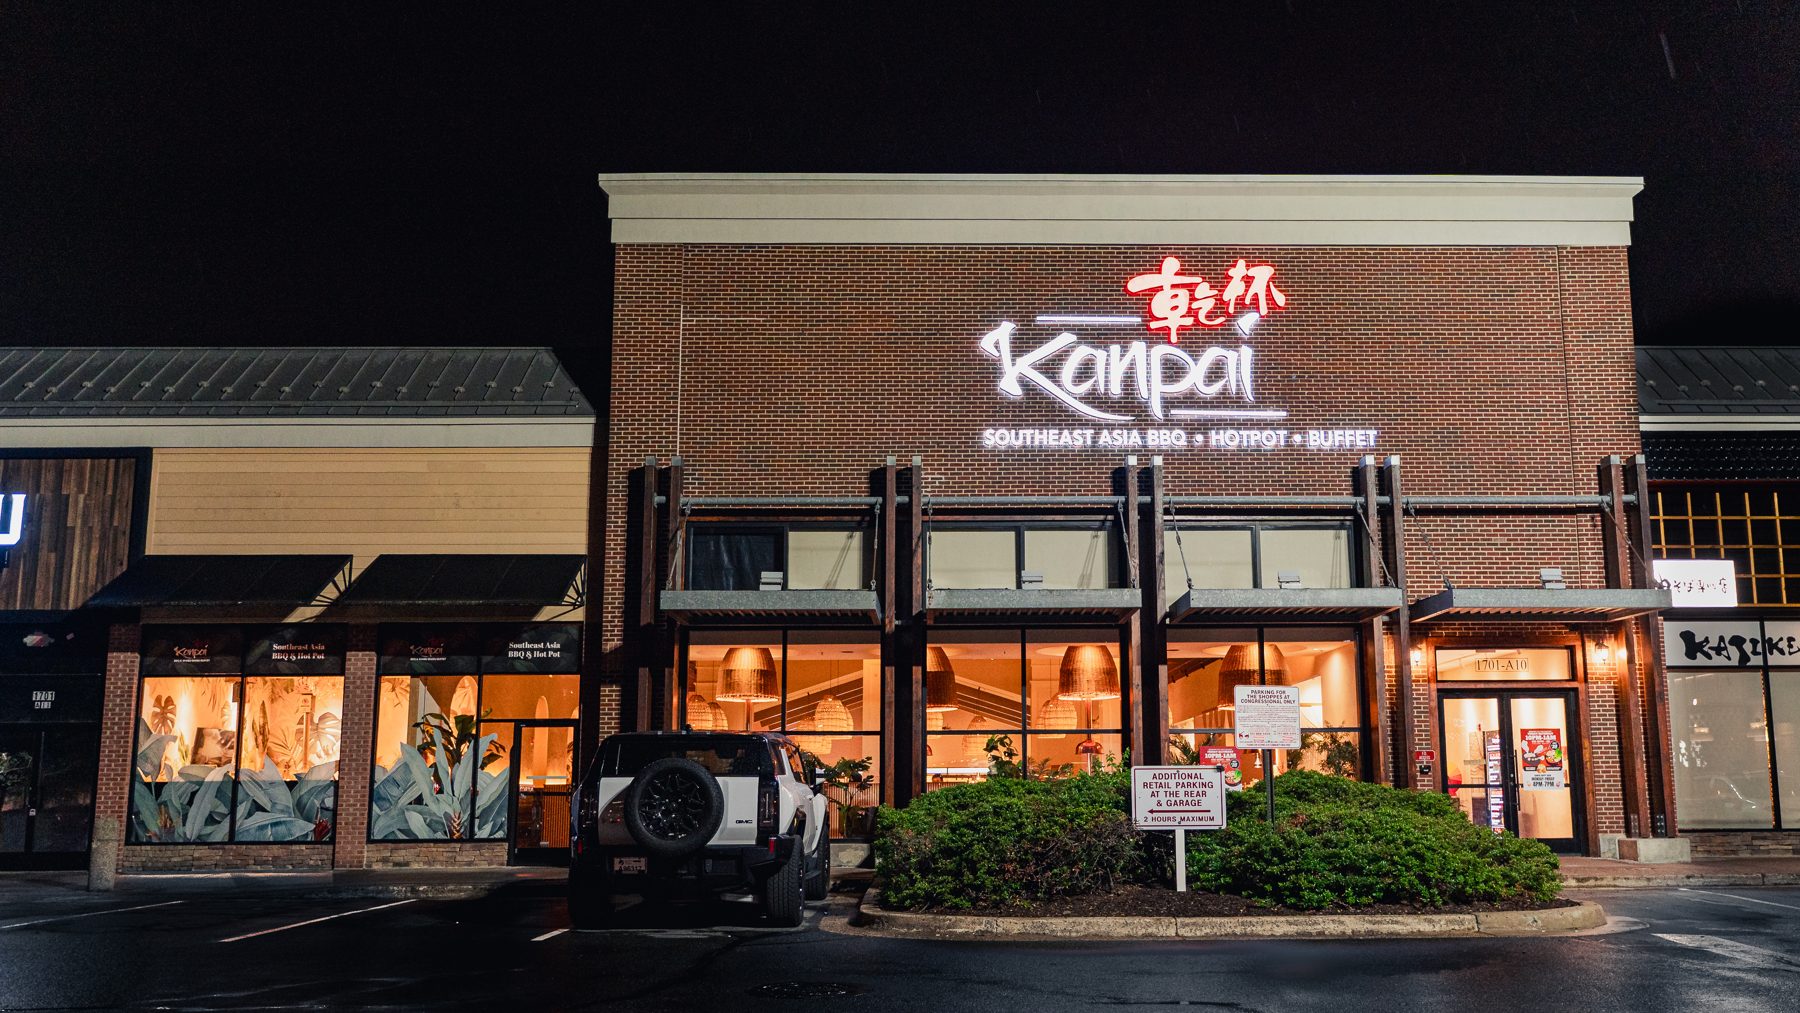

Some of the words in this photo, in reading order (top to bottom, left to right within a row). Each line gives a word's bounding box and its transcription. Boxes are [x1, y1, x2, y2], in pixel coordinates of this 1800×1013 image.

[1125, 256, 1286, 344] 乾杯
[980, 312, 1260, 421] Kanpai
[983, 428, 1095, 447] SOUTHEAST
[1099, 428, 1143, 447] ASIA
[1147, 428, 1187, 447] BBQ
[1210, 428, 1288, 447] HOTPOT
[1307, 428, 1378, 447] BUFFET
[508, 641, 544, 649] Southeast
[545, 641, 561, 649] Asia
[272, 652, 288, 660] BBQ
[508, 651, 524, 659] BBQ
[525, 651, 533, 659] &
[1476, 659, 1528, 671] 1701-A10
[33, 691, 55, 700] 1701
[1152, 772, 1205, 780] ADDITIONAL
[1142, 781, 1171, 789] RETAIL
[1175, 781, 1214, 789] PARKING
[1150, 790, 1160, 798] AT
[1163, 790, 1180, 798] THE
[1156, 799, 1163, 807] &
[1166, 799, 1202, 807] GARAGE
